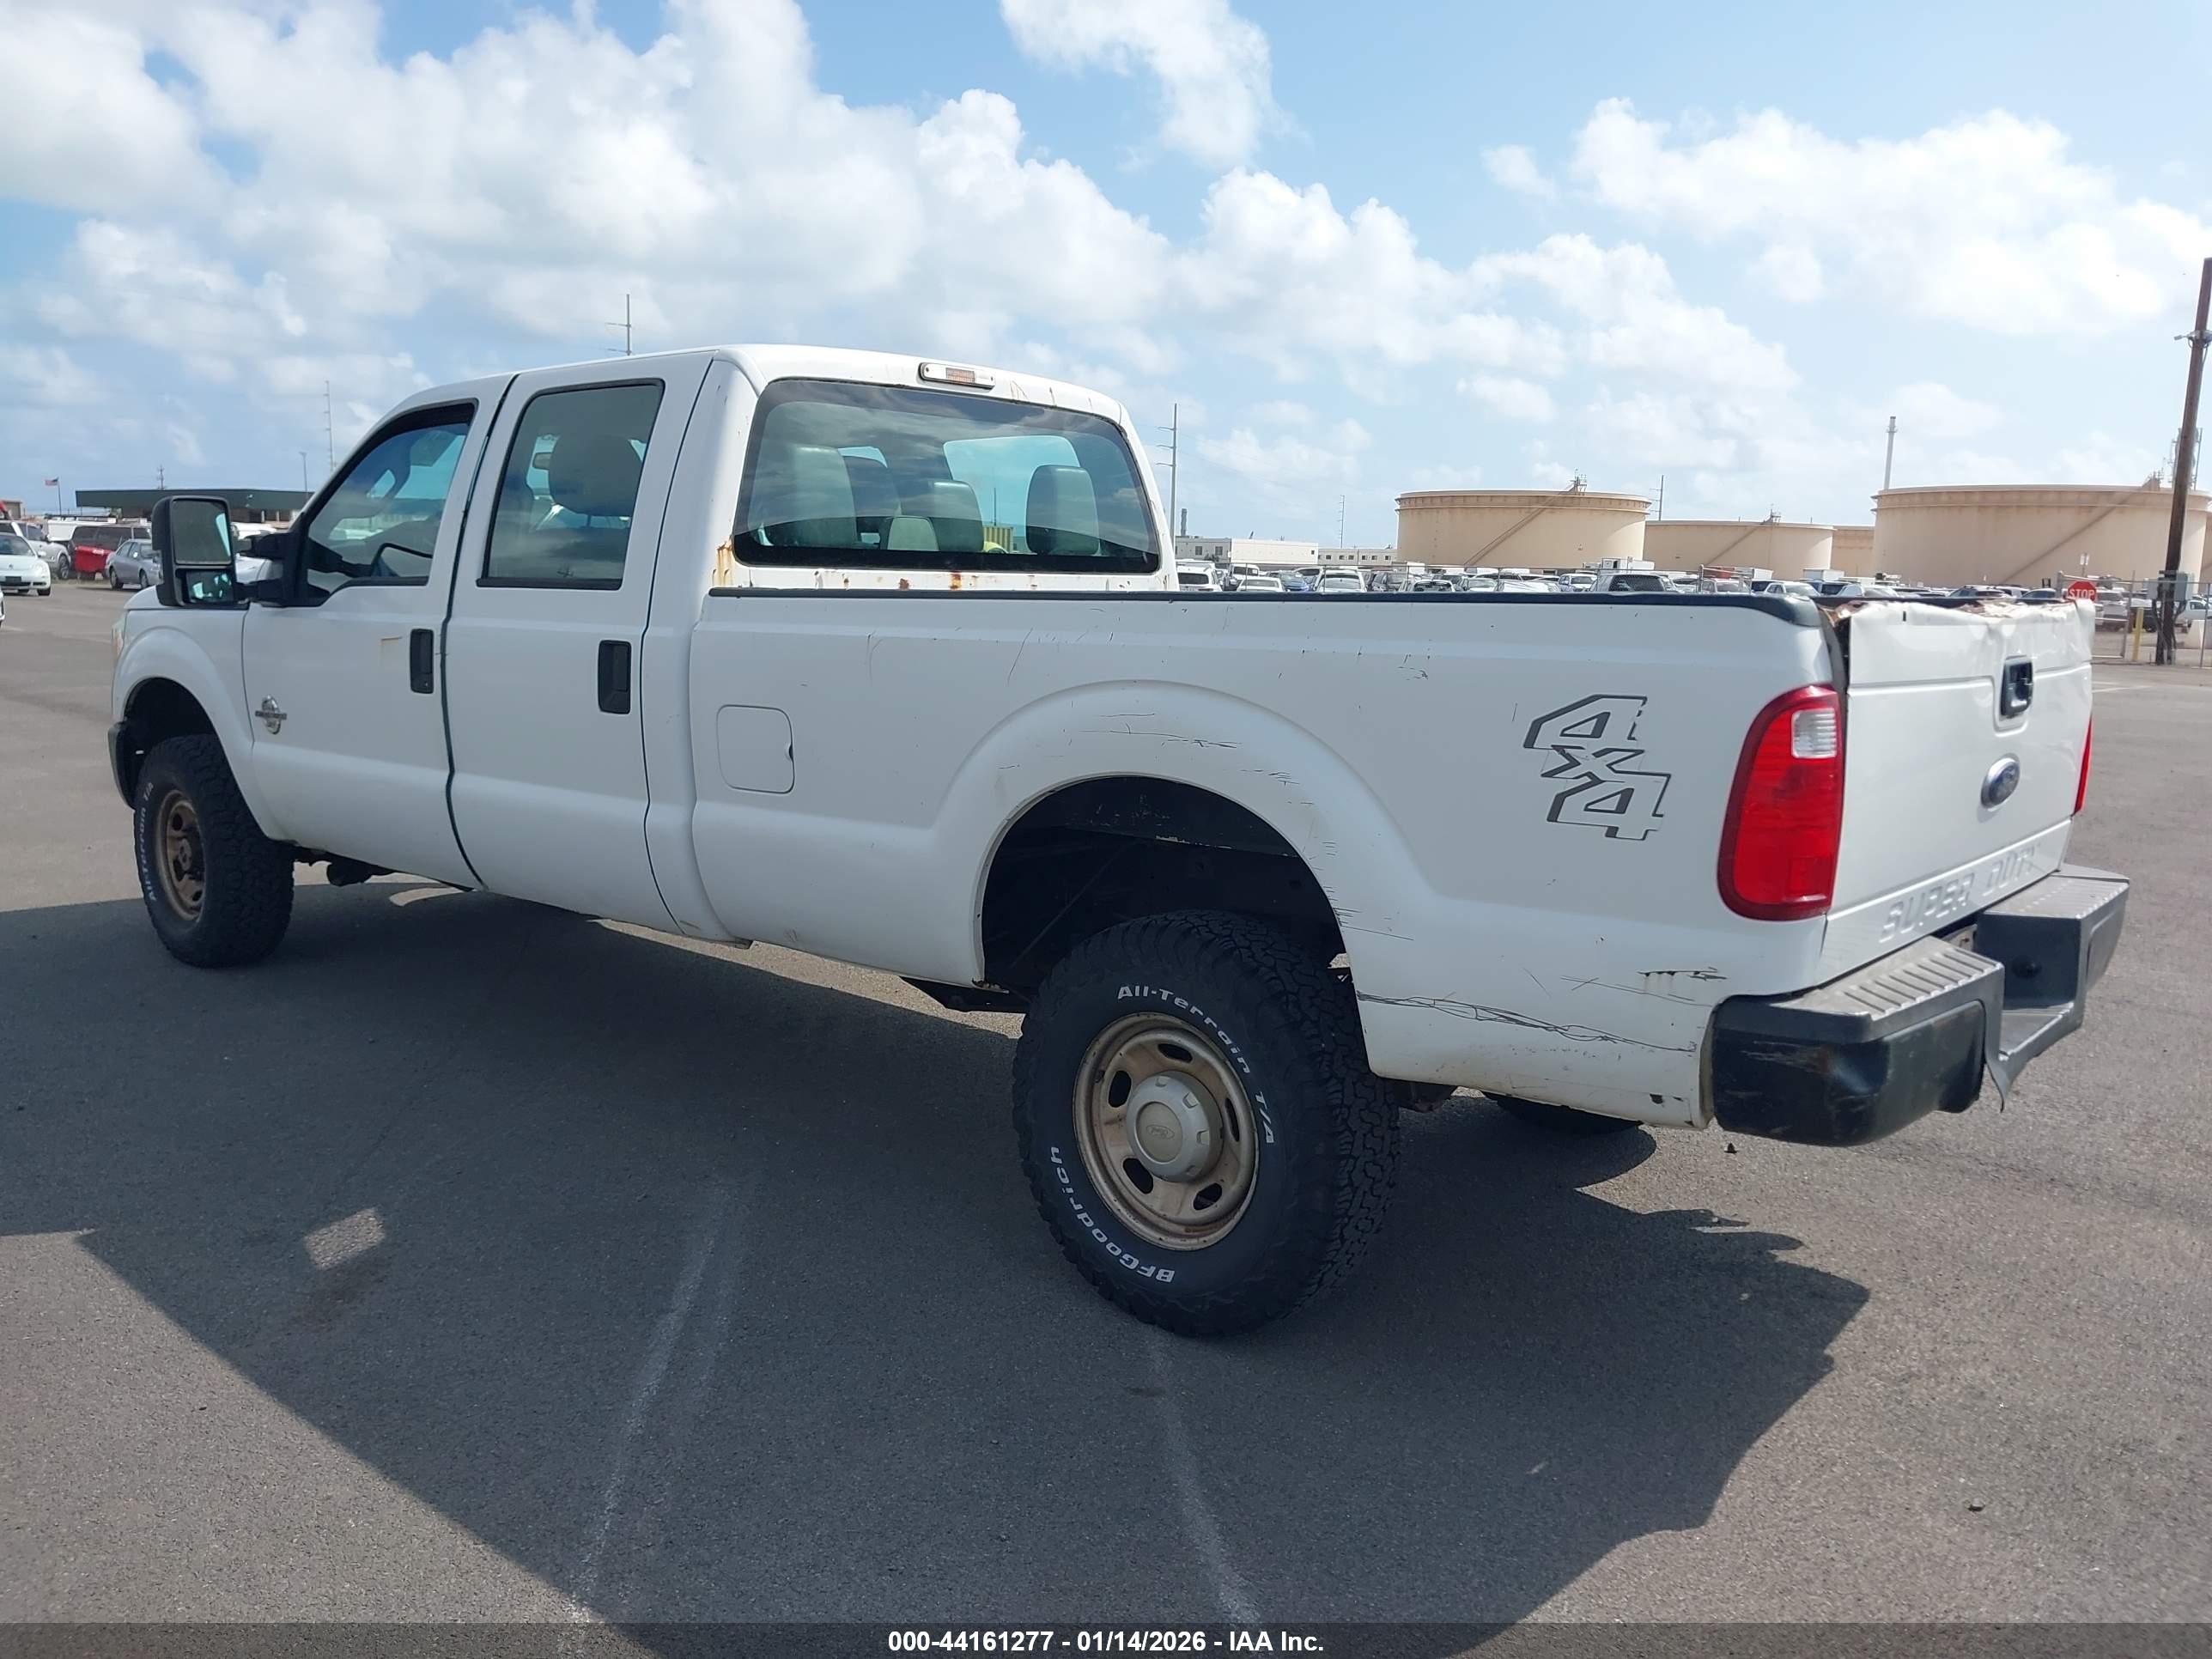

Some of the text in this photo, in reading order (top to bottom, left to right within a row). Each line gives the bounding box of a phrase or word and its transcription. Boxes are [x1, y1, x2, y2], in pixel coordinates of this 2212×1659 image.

[2069, 589, 2095, 601] STOP
[1878, 872, 1975, 944] SUPER
[1117, 985, 1275, 1144] All-Terrain T/A
[1050, 1146, 1176, 1283] BFGoodrich
